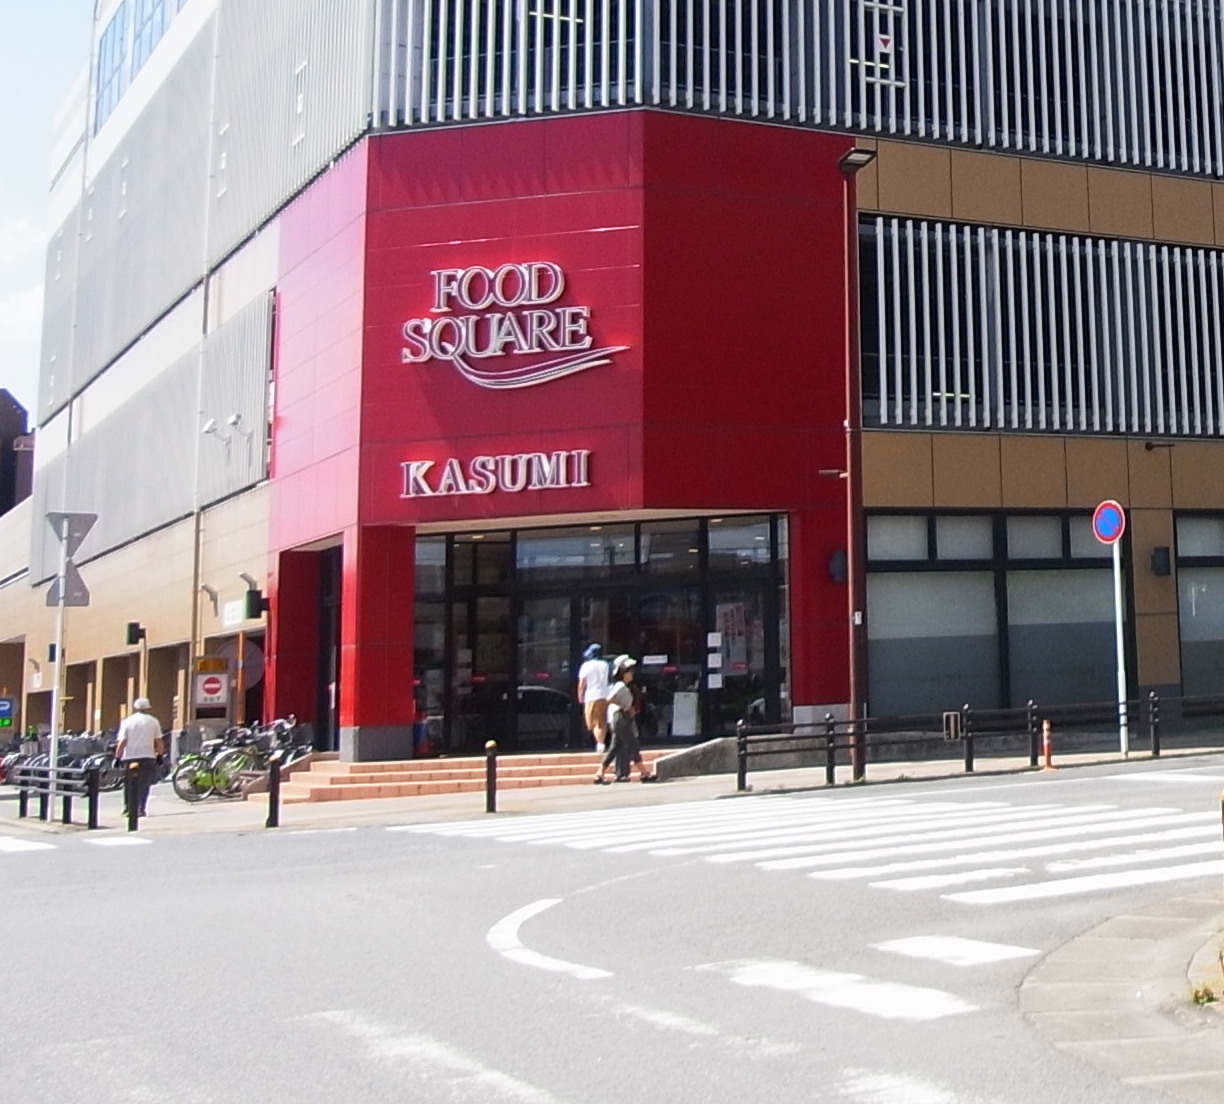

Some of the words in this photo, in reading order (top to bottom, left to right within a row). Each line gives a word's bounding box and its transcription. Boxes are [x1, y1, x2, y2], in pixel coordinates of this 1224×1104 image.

[430, 261, 566, 312] FOOD
[401, 305, 597, 370] SQUARE
[400, 449, 592, 499] KASUMI
